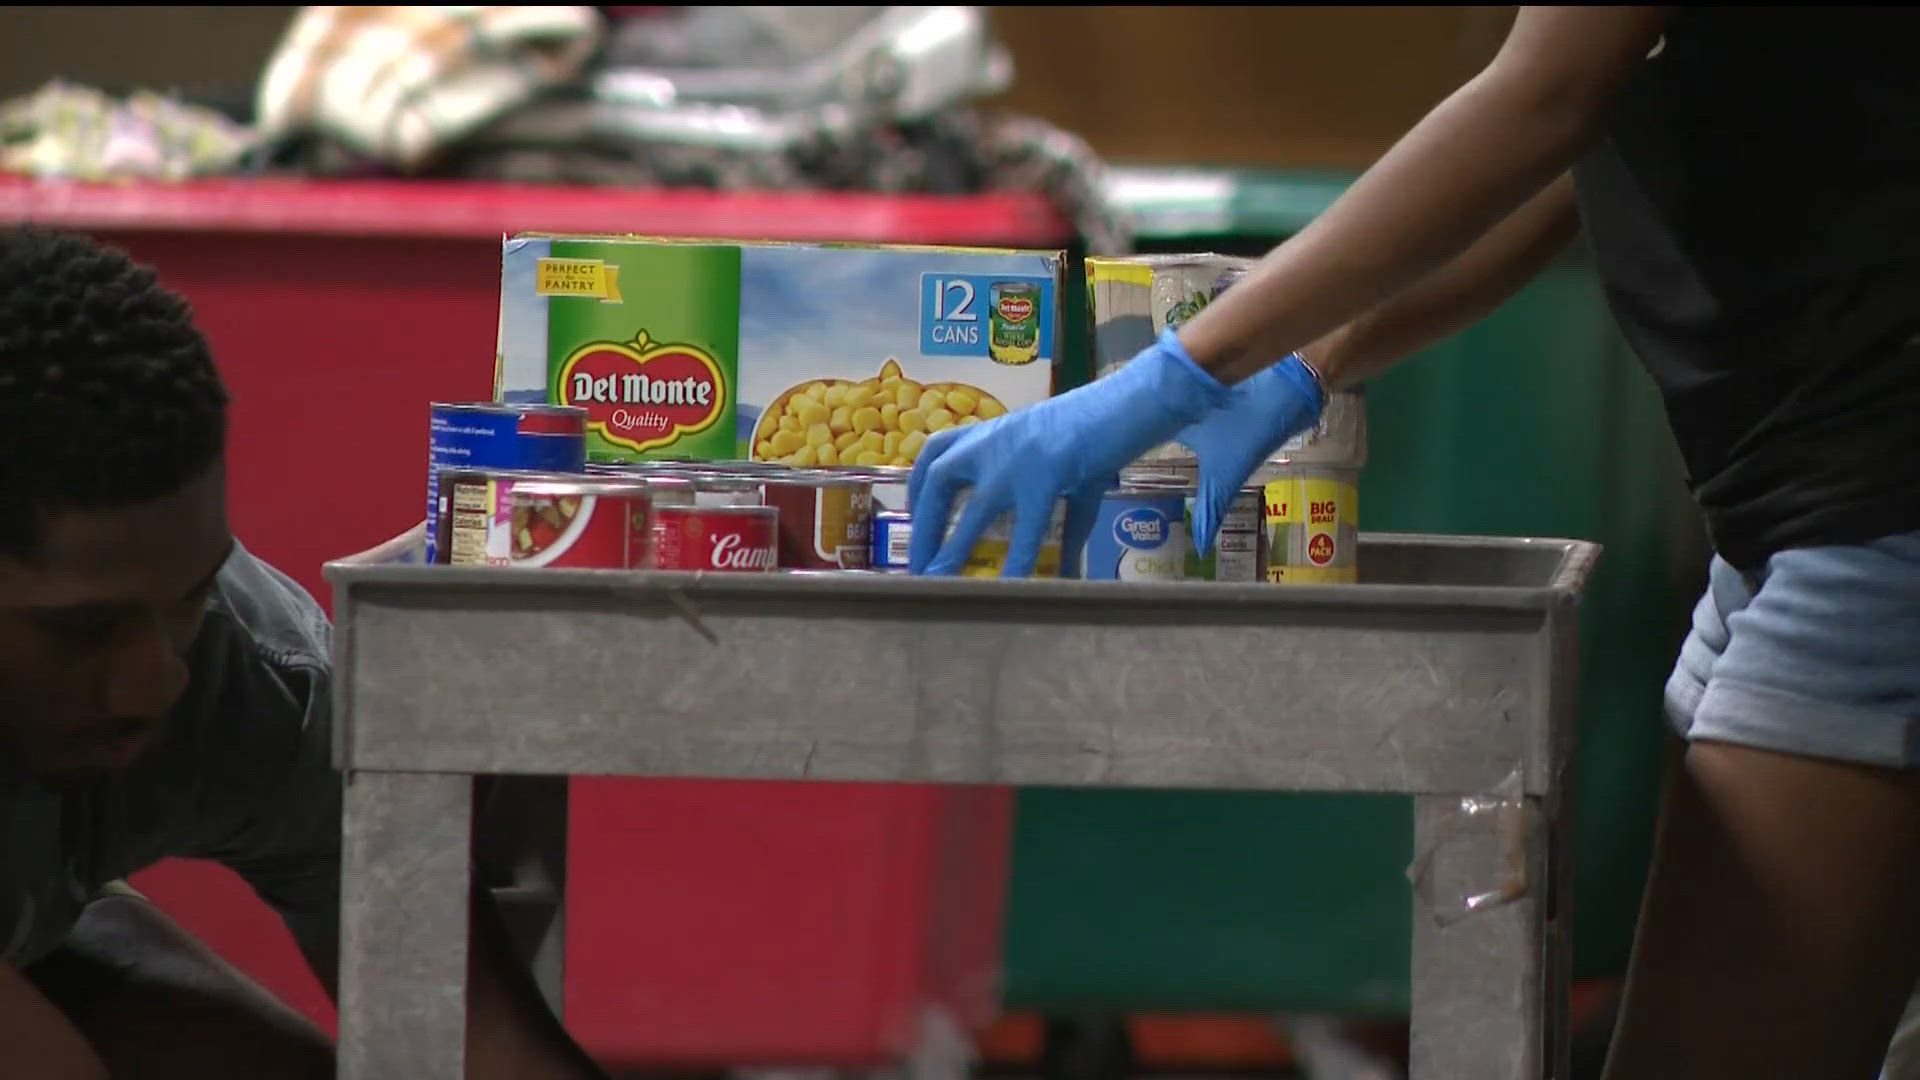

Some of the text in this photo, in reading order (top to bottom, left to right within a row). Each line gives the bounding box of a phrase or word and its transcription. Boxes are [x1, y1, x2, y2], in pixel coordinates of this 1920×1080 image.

[545, 263, 596, 275] PERFECT
[545, 280, 596, 291] PANTRY
[934, 279, 979, 321] 12
[932, 325, 979, 345] CANS
[573, 372, 712, 406] Del Monte
[611, 409, 669, 432] Quality
[1310, 501, 1336, 515] BIG
[1121, 517, 1162, 532] Great
[1130, 531, 1161, 541] Value
[1317, 535, 1326, 549] 4
[1310, 546, 1332, 558] PACK
